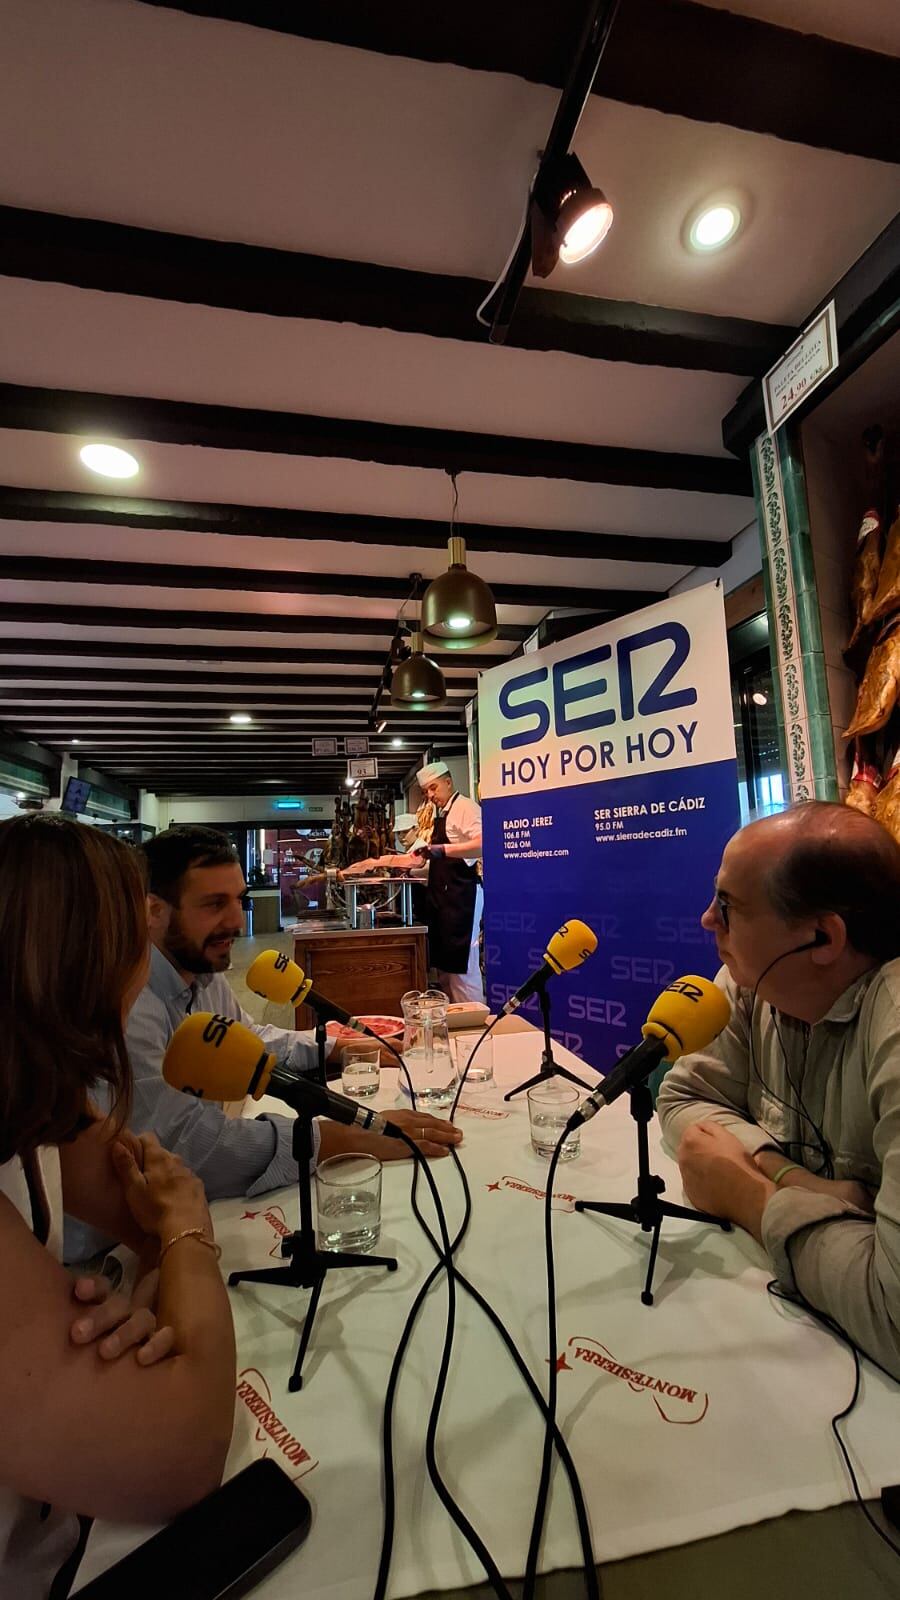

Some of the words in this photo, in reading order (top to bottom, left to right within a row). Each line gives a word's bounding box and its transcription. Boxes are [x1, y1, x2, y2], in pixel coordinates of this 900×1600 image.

[499, 621, 698, 751] SER
[501, 753, 550, 786] HOY
[560, 740, 615, 776] POR
[626, 721, 698, 764] HOY
[594, 809, 611, 821] SER
[613, 804, 648, 818] SIERRA
[651, 802, 666, 814] DE
[668, 796, 706, 812] CÁDIZ
[503, 818, 529, 830] RADIO
[531, 816, 553, 828] JEREZ
[595, 822, 611, 831] 95.0
[612, 820, 624, 830] FM
[521, 830, 531, 838] FM
[595, 827, 688, 843] www.sierradecadiz.fm
[504, 841, 518, 849] 1026
[519, 840, 532, 848] OM
[504, 849, 569, 859] www.radiojerez.com
[568, 994, 627, 1028] SER
[574, 1347, 698, 1403] MONTESIERRA
